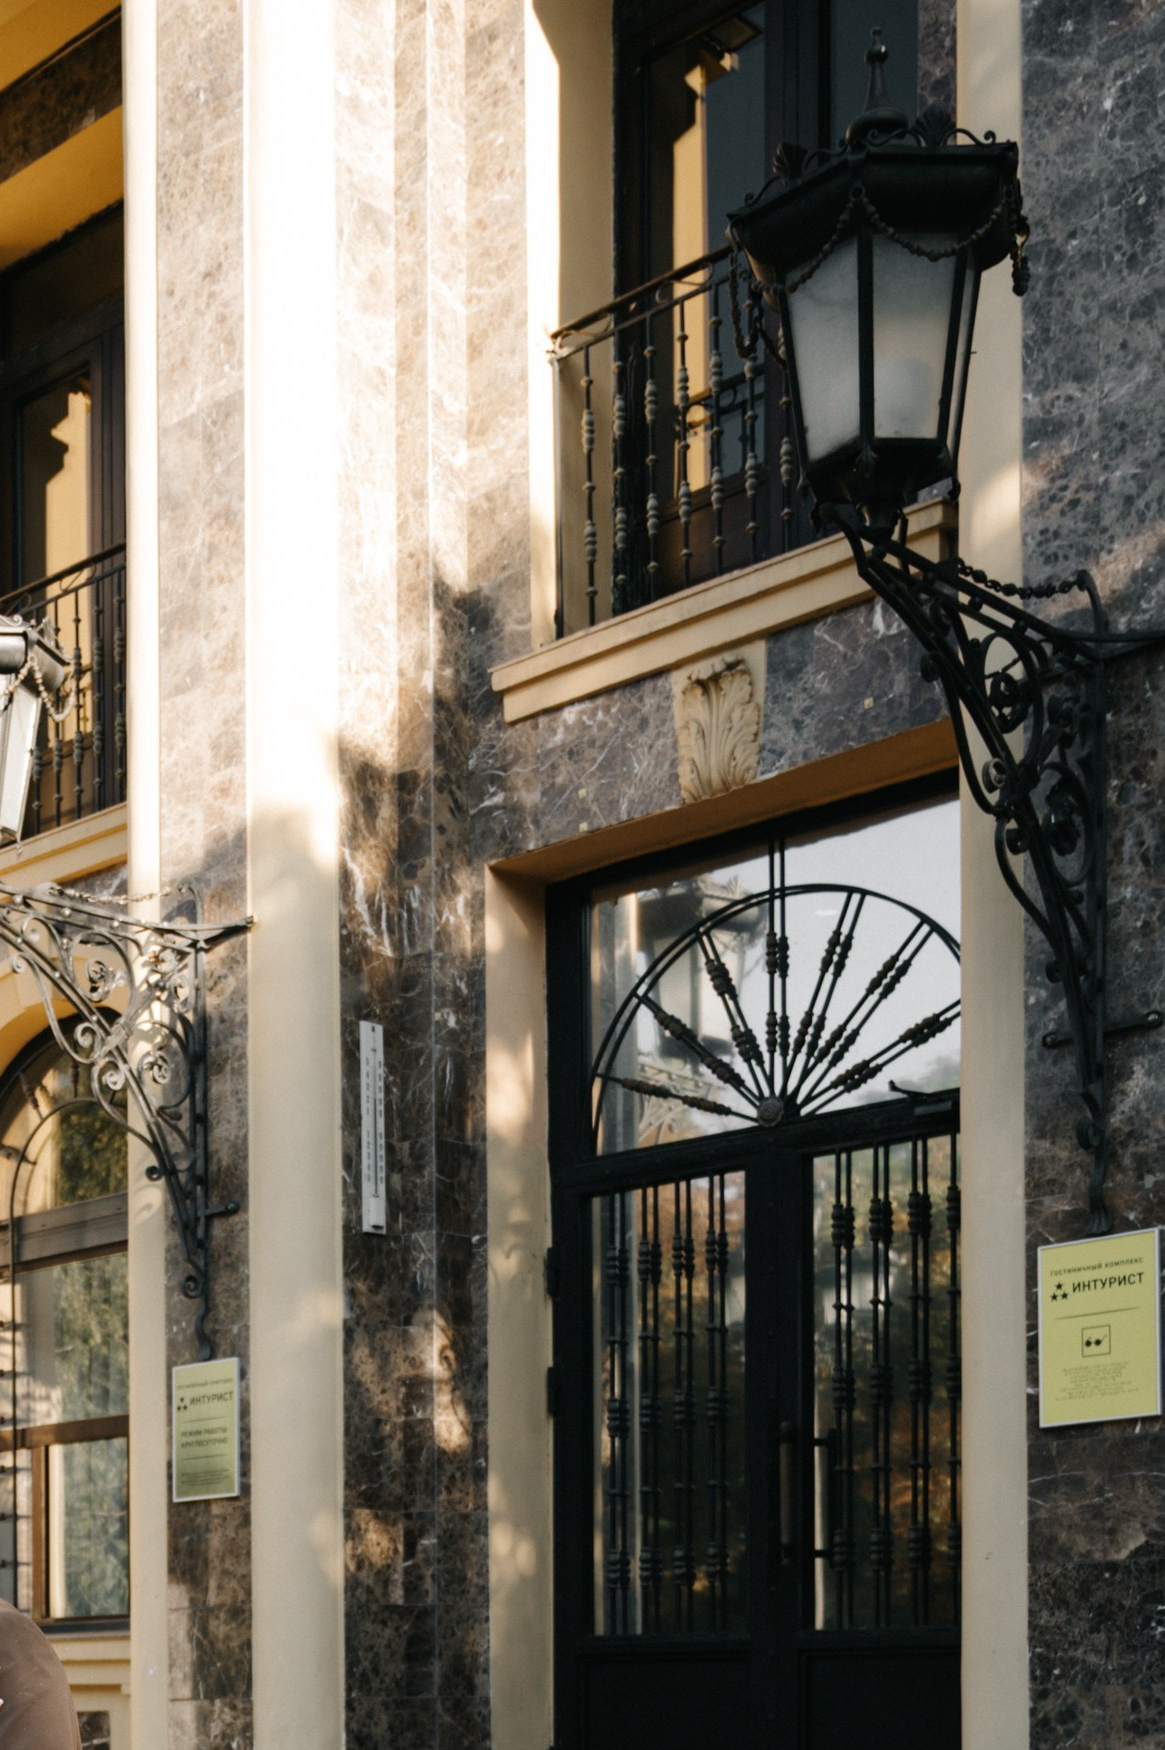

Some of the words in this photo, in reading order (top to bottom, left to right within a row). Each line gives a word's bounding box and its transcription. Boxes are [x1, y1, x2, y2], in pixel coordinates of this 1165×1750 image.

[1050, 1262, 1102, 1276] ГОСТИНИЧНЫЙ
[1105, 1257, 1143, 1268] КОМПЛЕКС
[1072, 1272, 1144, 1293] ИНТУРИСТ
[189, 1391, 233, 1406] ИНТУРИСТ
